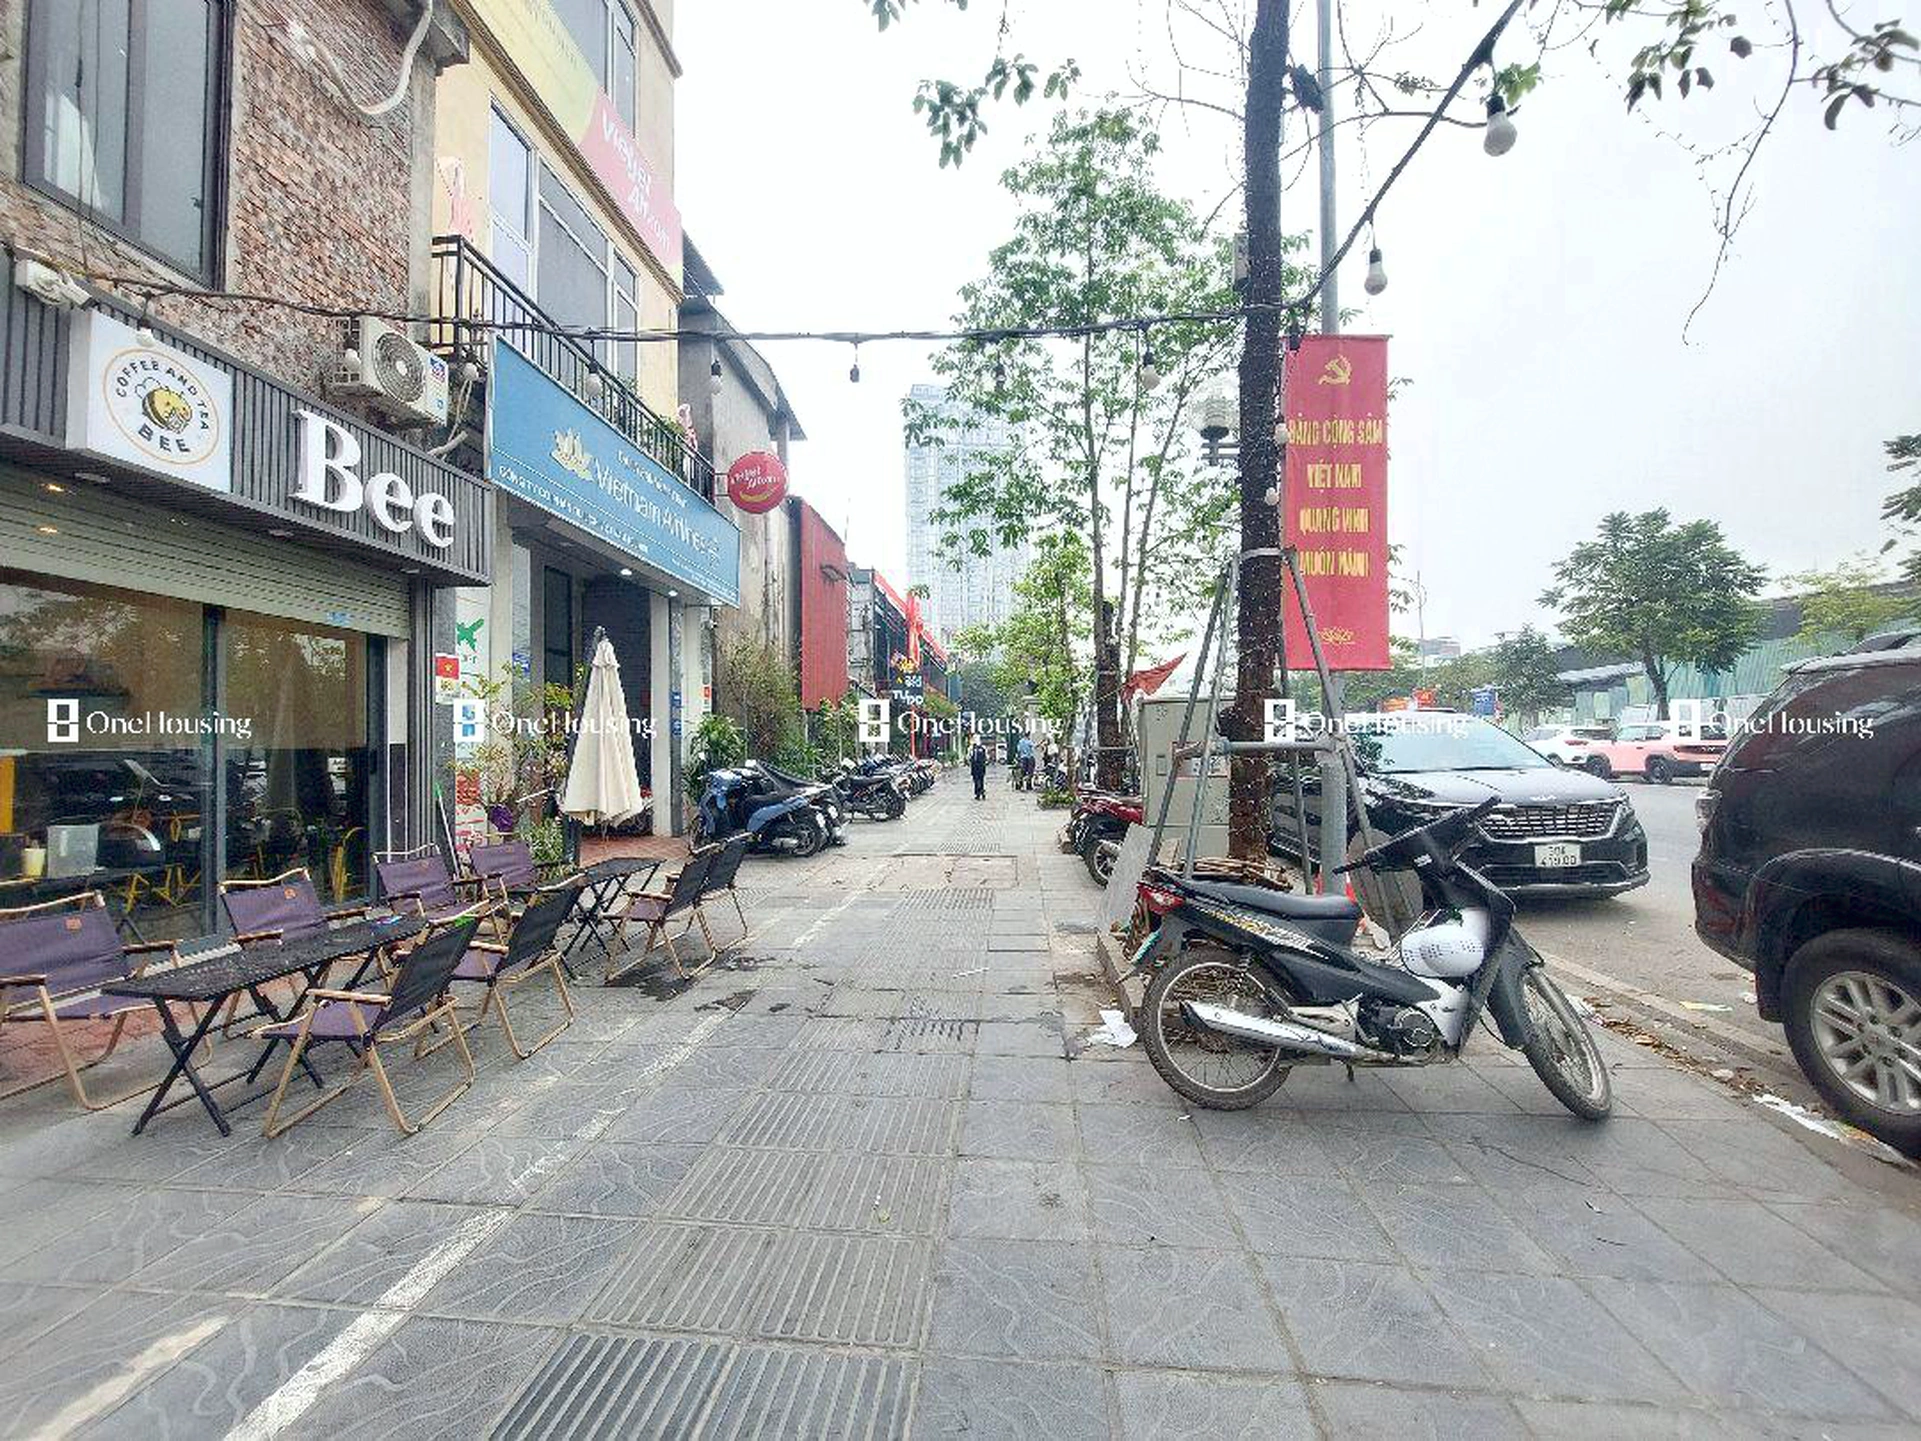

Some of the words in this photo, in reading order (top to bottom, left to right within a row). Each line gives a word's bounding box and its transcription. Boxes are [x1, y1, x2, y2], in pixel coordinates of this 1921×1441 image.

[115, 359, 159, 399] COFFEE
[165, 367, 198, 396] AND
[196, 399, 210, 430] TEA
[138, 423, 191, 453] BEE
[288, 408, 455, 548] Bee
